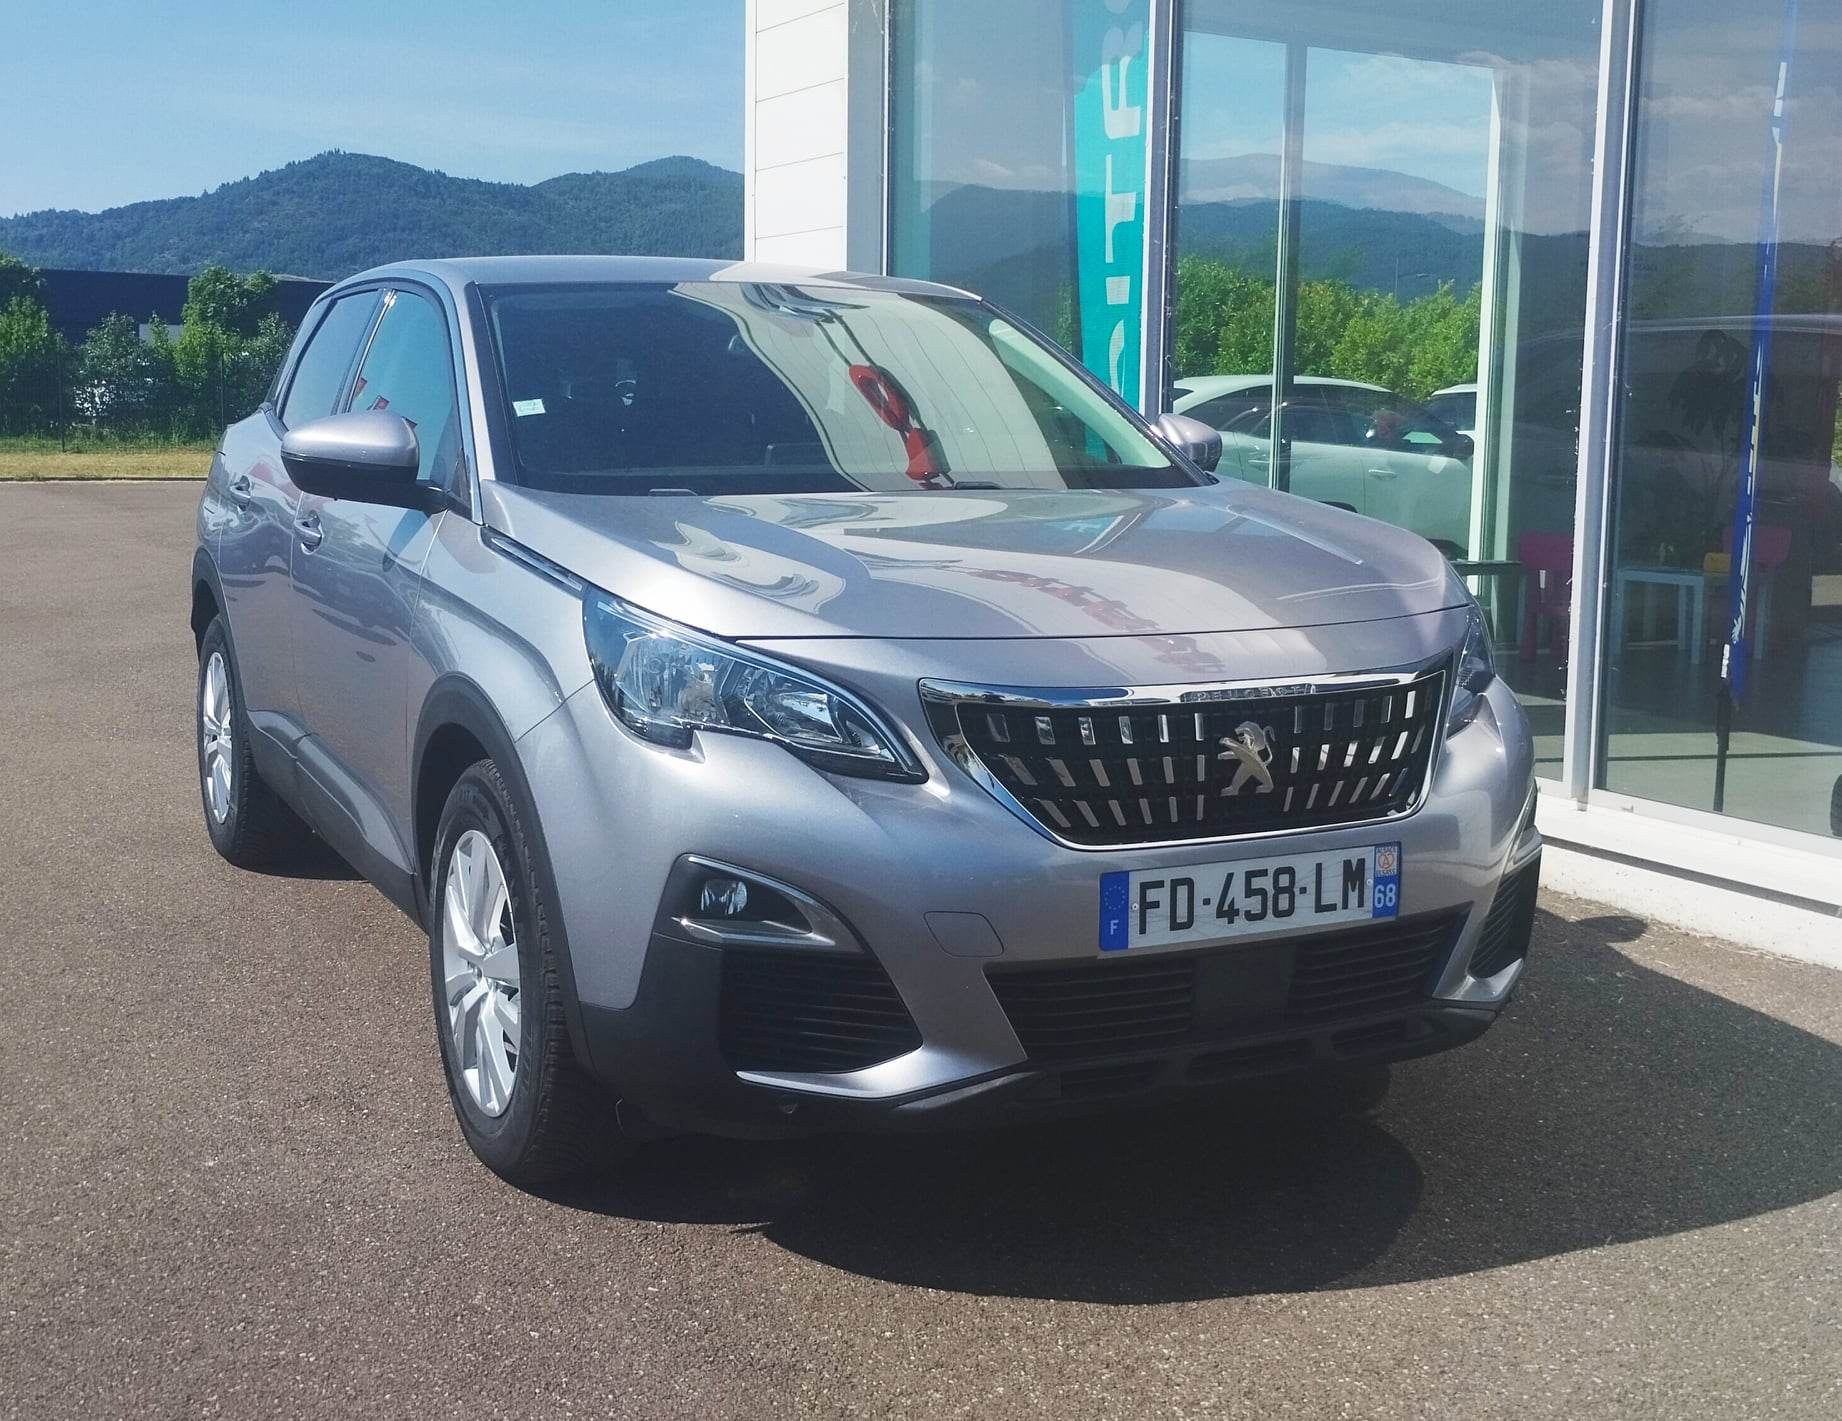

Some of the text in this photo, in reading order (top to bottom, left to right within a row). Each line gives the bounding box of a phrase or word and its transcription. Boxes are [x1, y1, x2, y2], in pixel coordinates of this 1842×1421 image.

[1101, 0, 1142, 398] ITR
[1138, 857, 1366, 934] FD-458-LM
[1374, 883, 1396, 908] 68
[1109, 919, 1119, 935] F
